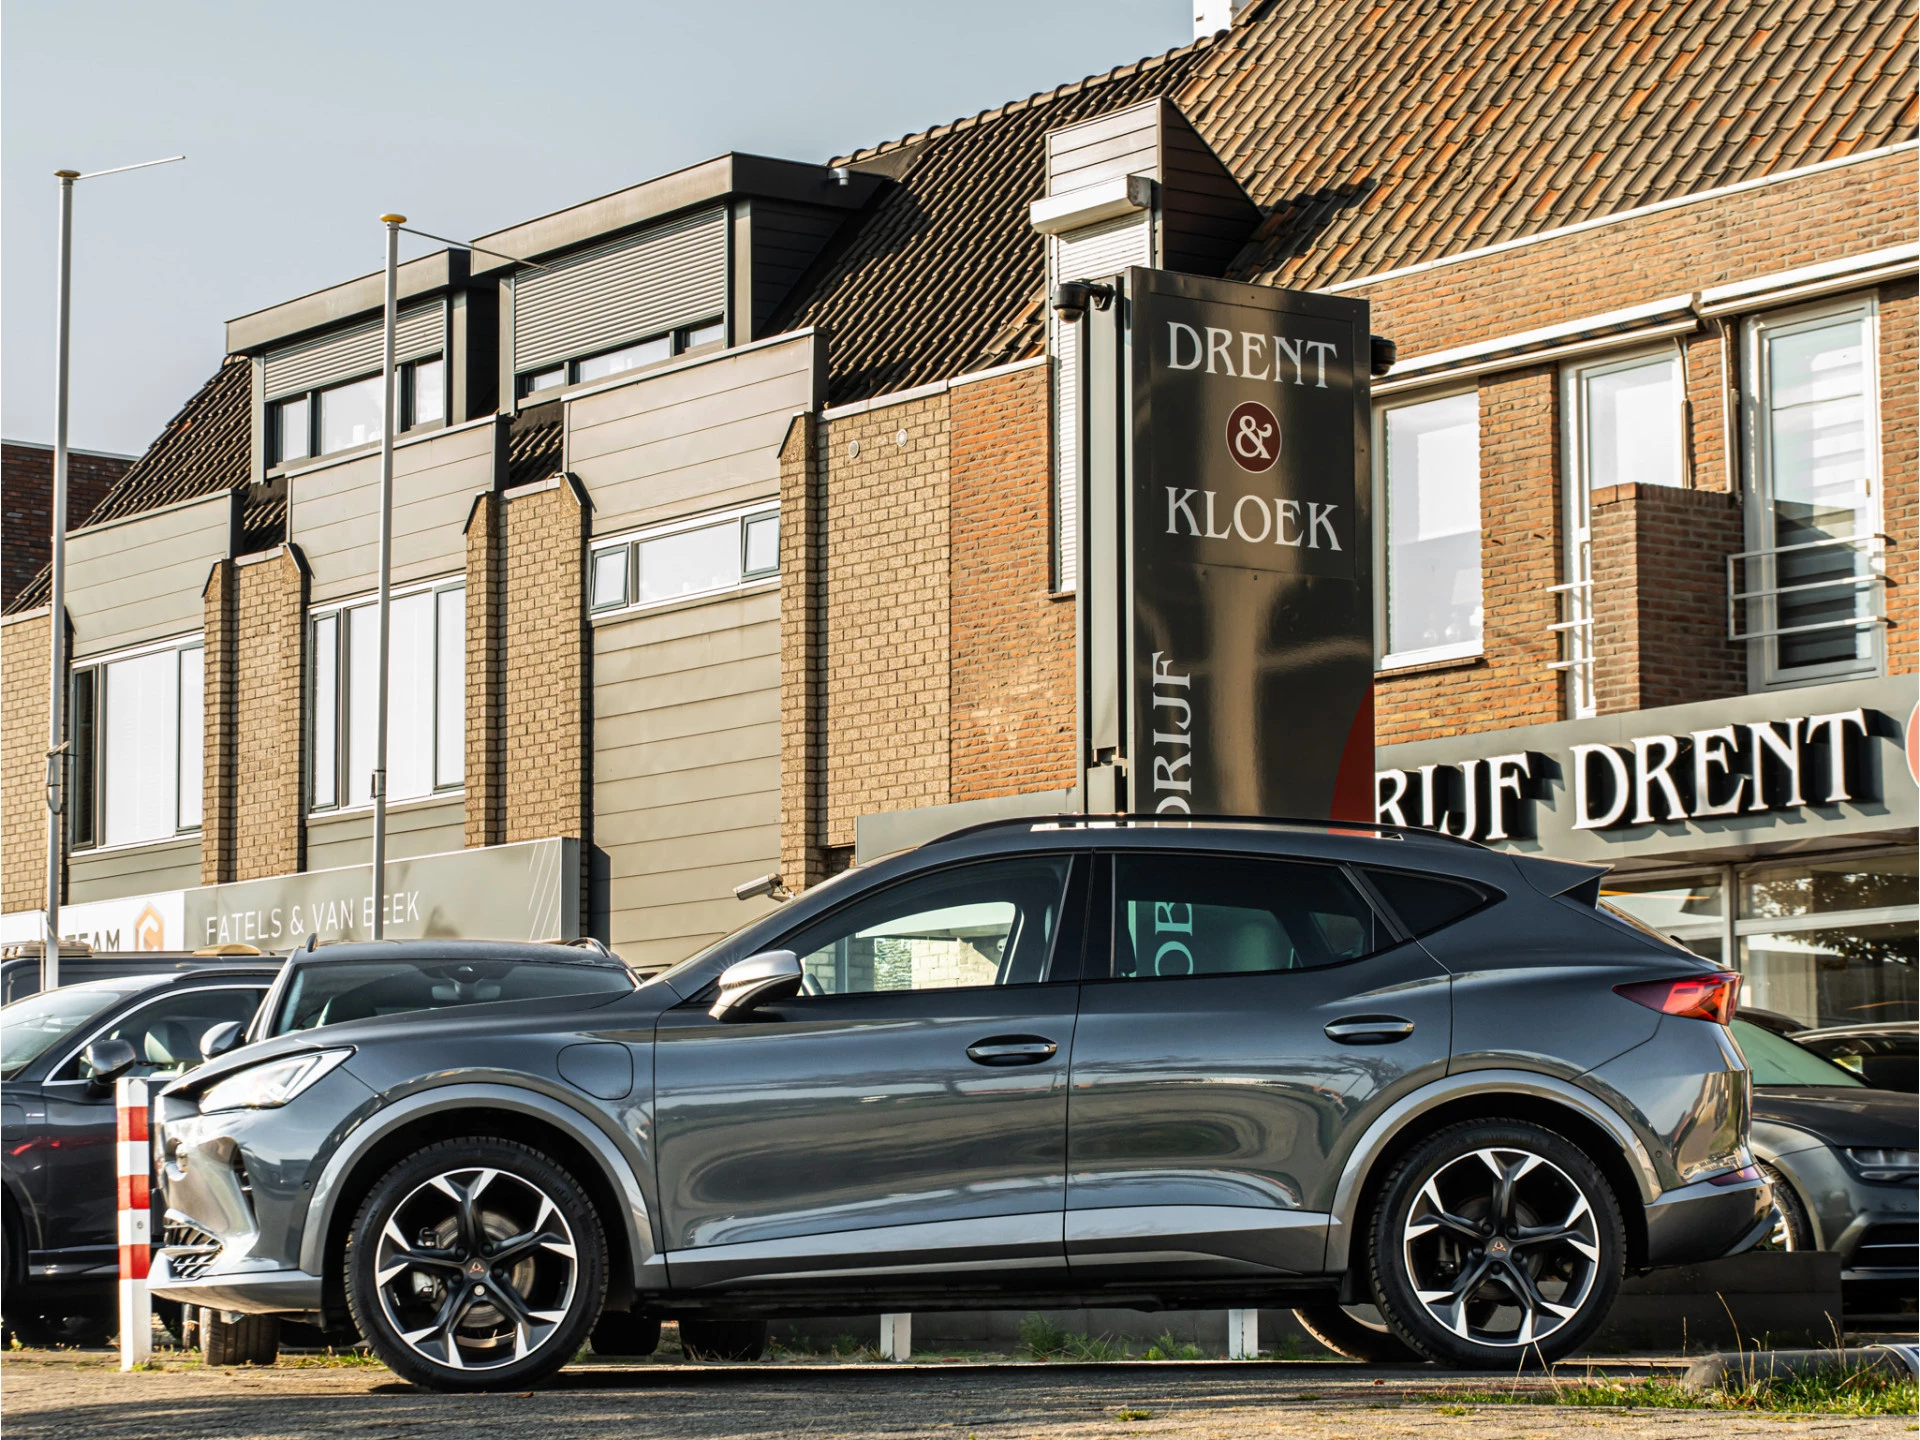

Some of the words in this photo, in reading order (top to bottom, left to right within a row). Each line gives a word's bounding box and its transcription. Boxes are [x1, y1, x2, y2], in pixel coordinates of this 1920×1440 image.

[1166, 321, 1338, 389] DRENT
[1235, 415, 1273, 460] &
[1165, 486, 1343, 551] KLOEK
[1570, 707, 1869, 831] DRENT
[64, 928, 120, 952] AM
[206, 908, 282, 945] FATELS
[290, 905, 304, 935] &
[312, 898, 354, 933] VAN
